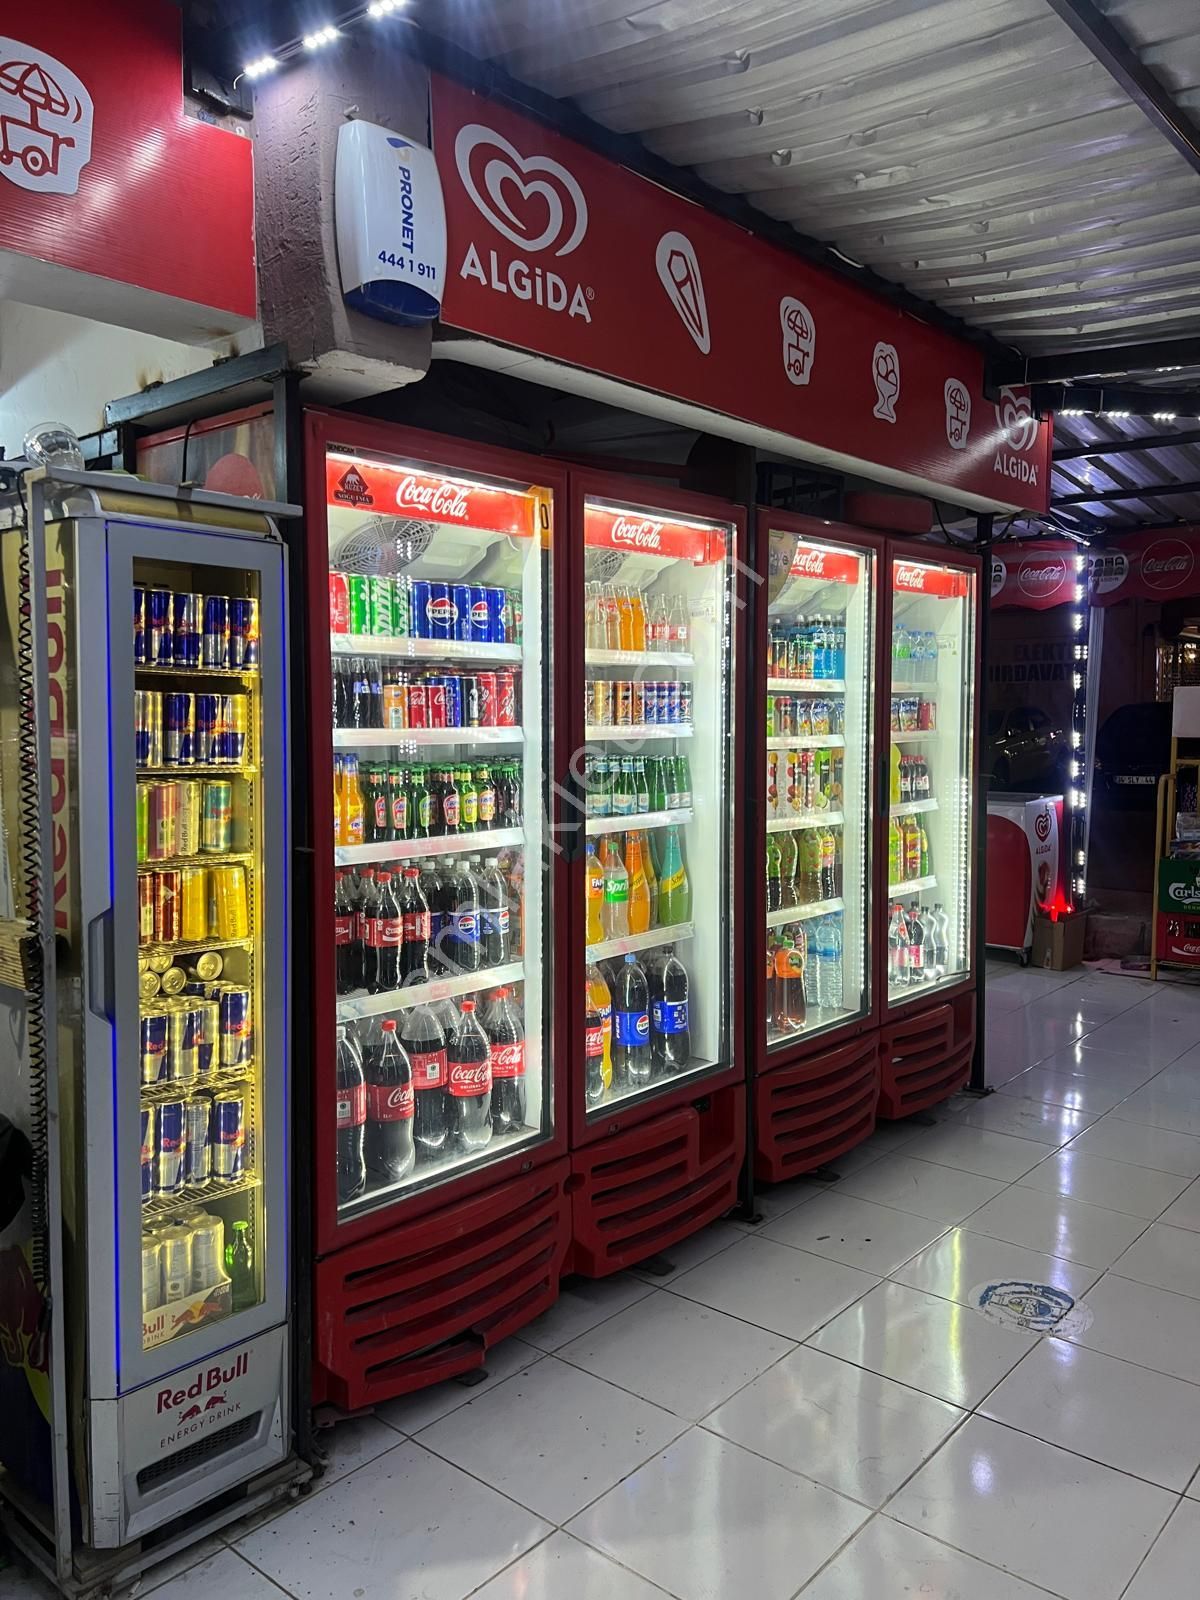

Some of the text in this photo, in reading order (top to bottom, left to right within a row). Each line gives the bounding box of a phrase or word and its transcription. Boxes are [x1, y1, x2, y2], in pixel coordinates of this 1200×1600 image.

[398, 165, 414, 254] PRONET
[378, 250, 436, 280] 444 1 911
[396, 476, 471, 519] Coca-Cola
[611, 516, 664, 549] Coca-Cola
[896, 566, 926, 590] Coca-Cola
[1020, 565, 1063, 582] Coca-Cola
[1143, 554, 1187, 574] Coca-Cola
[156, 1351, 249, 1415] Red Bull
[160, 1402, 242, 1449] ENERGY DRINK
